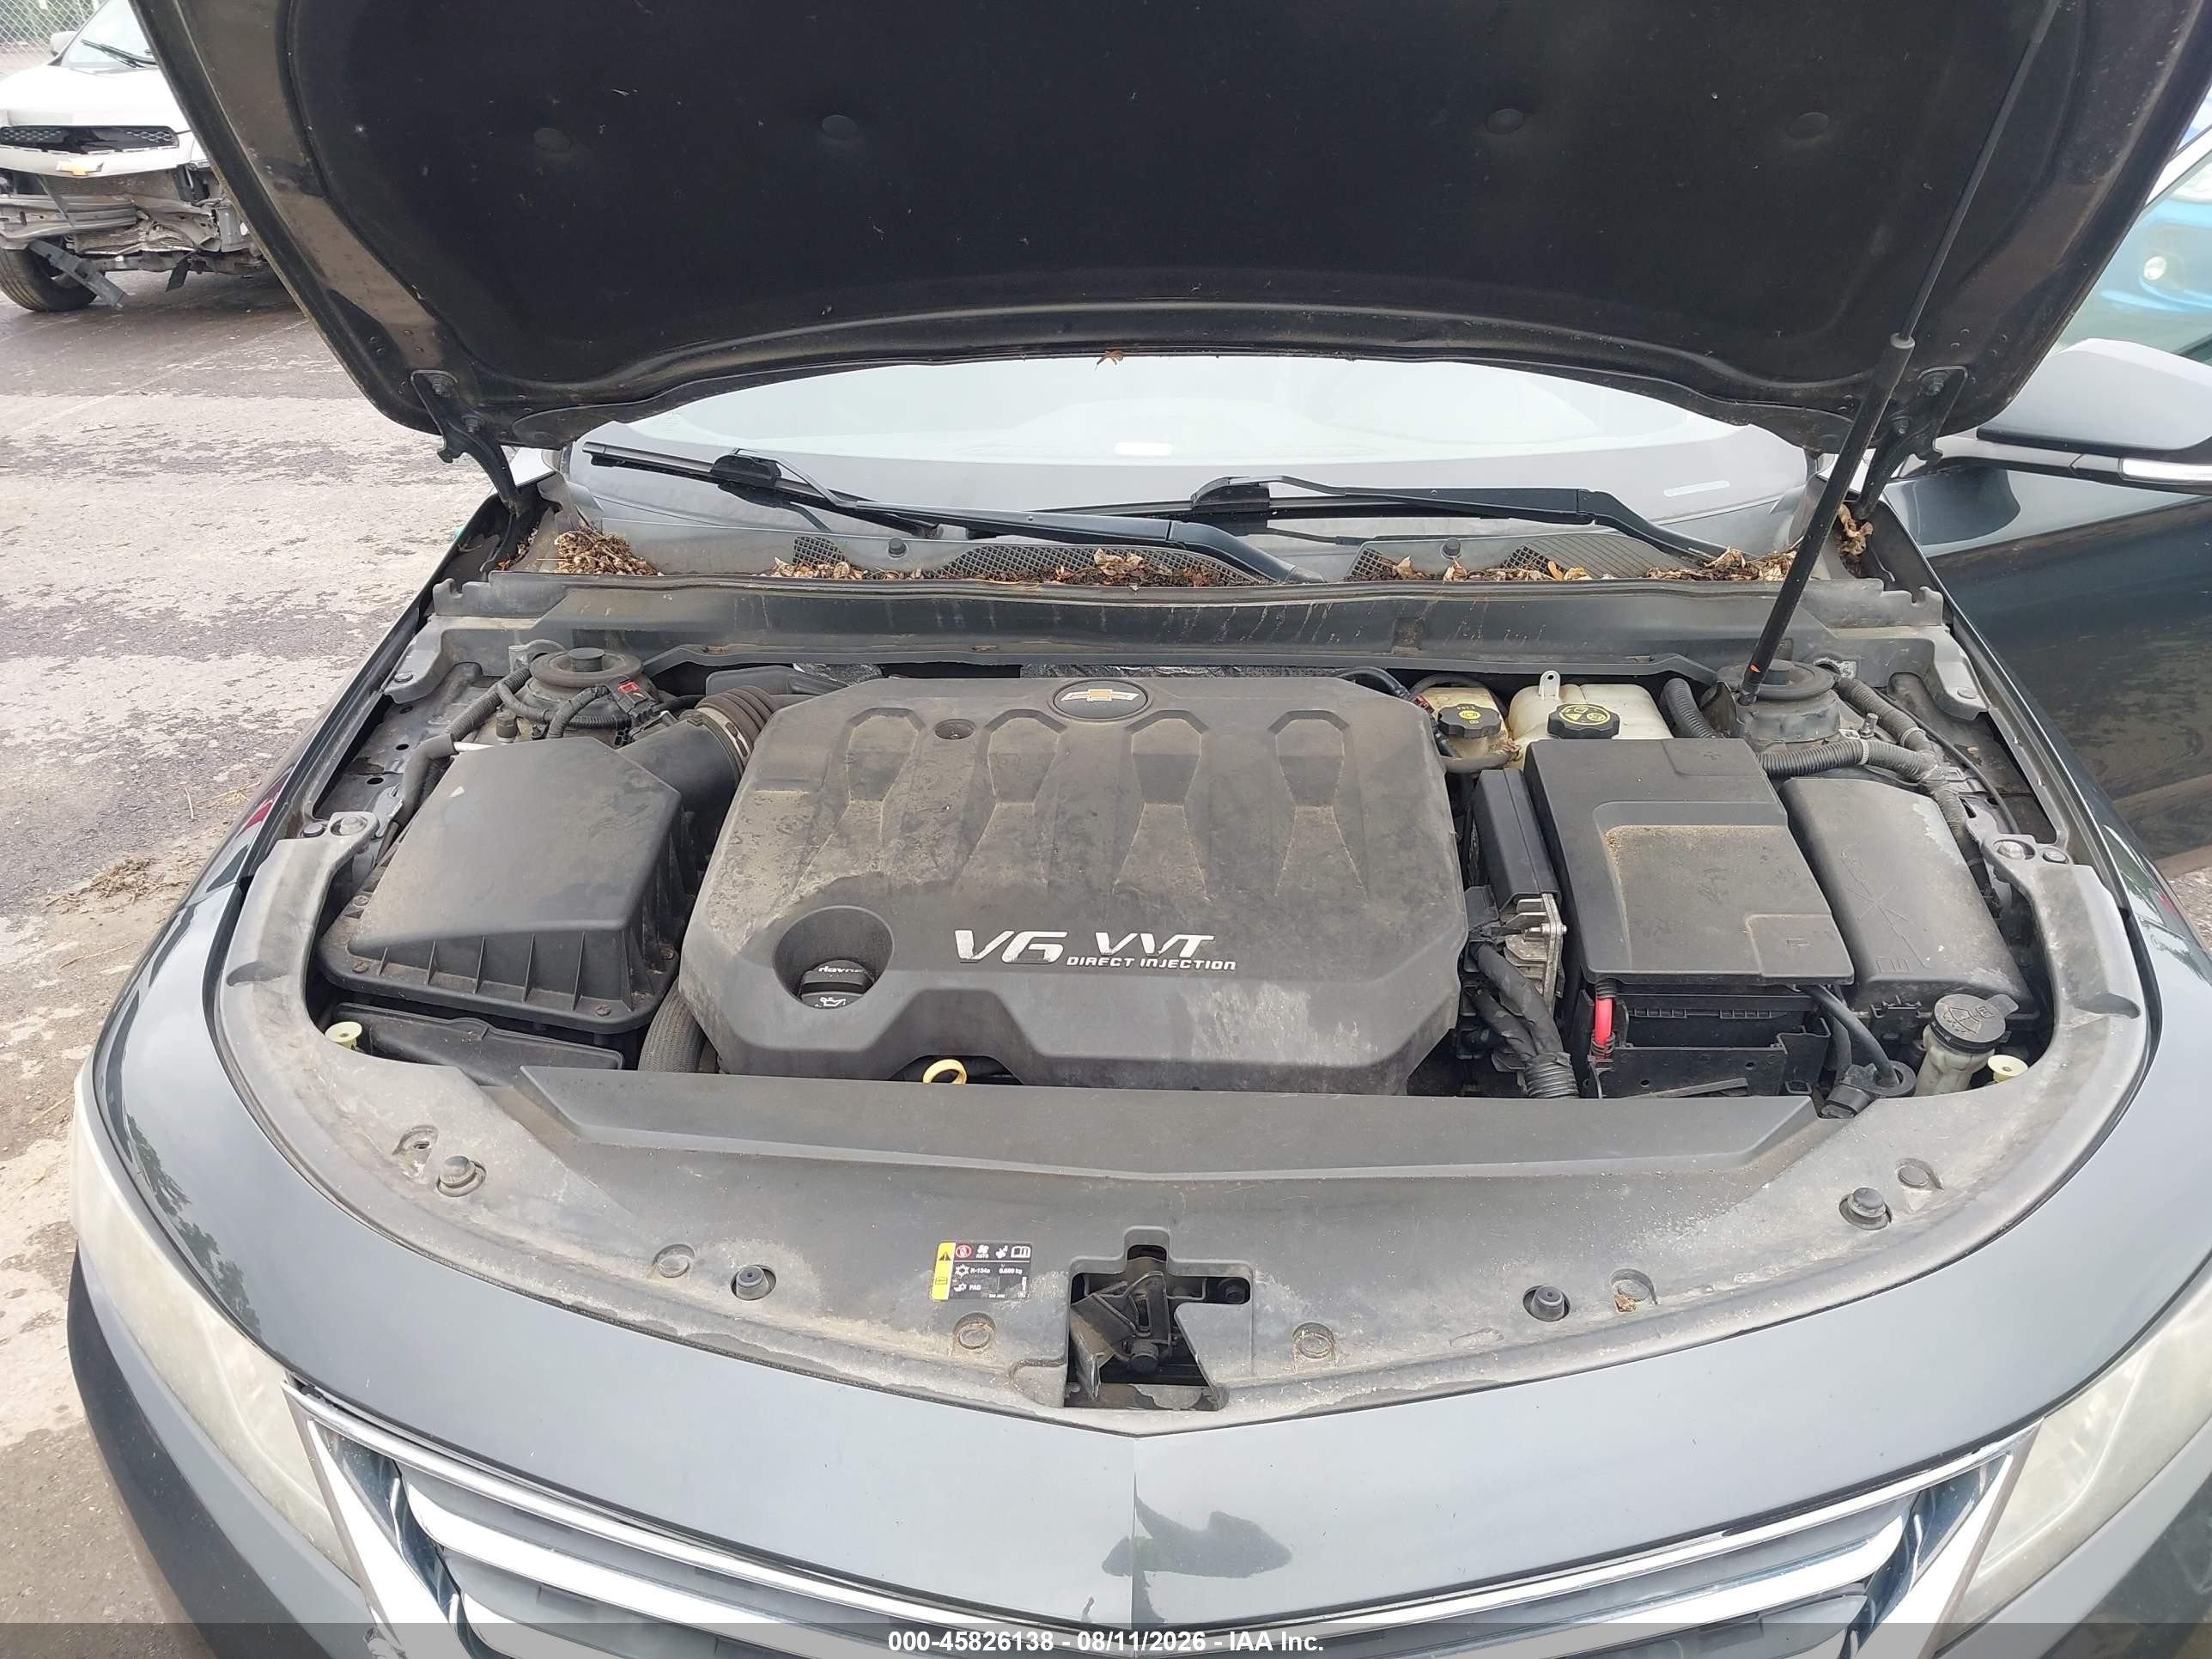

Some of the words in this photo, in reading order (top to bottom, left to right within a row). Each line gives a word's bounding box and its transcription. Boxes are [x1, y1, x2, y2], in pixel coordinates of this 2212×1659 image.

[954, 930, 1068, 963] V6
[1095, 932, 1215, 957] VVT
[1066, 956, 1135, 968] DIRECT
[1139, 957, 1237, 971] INJECTION
